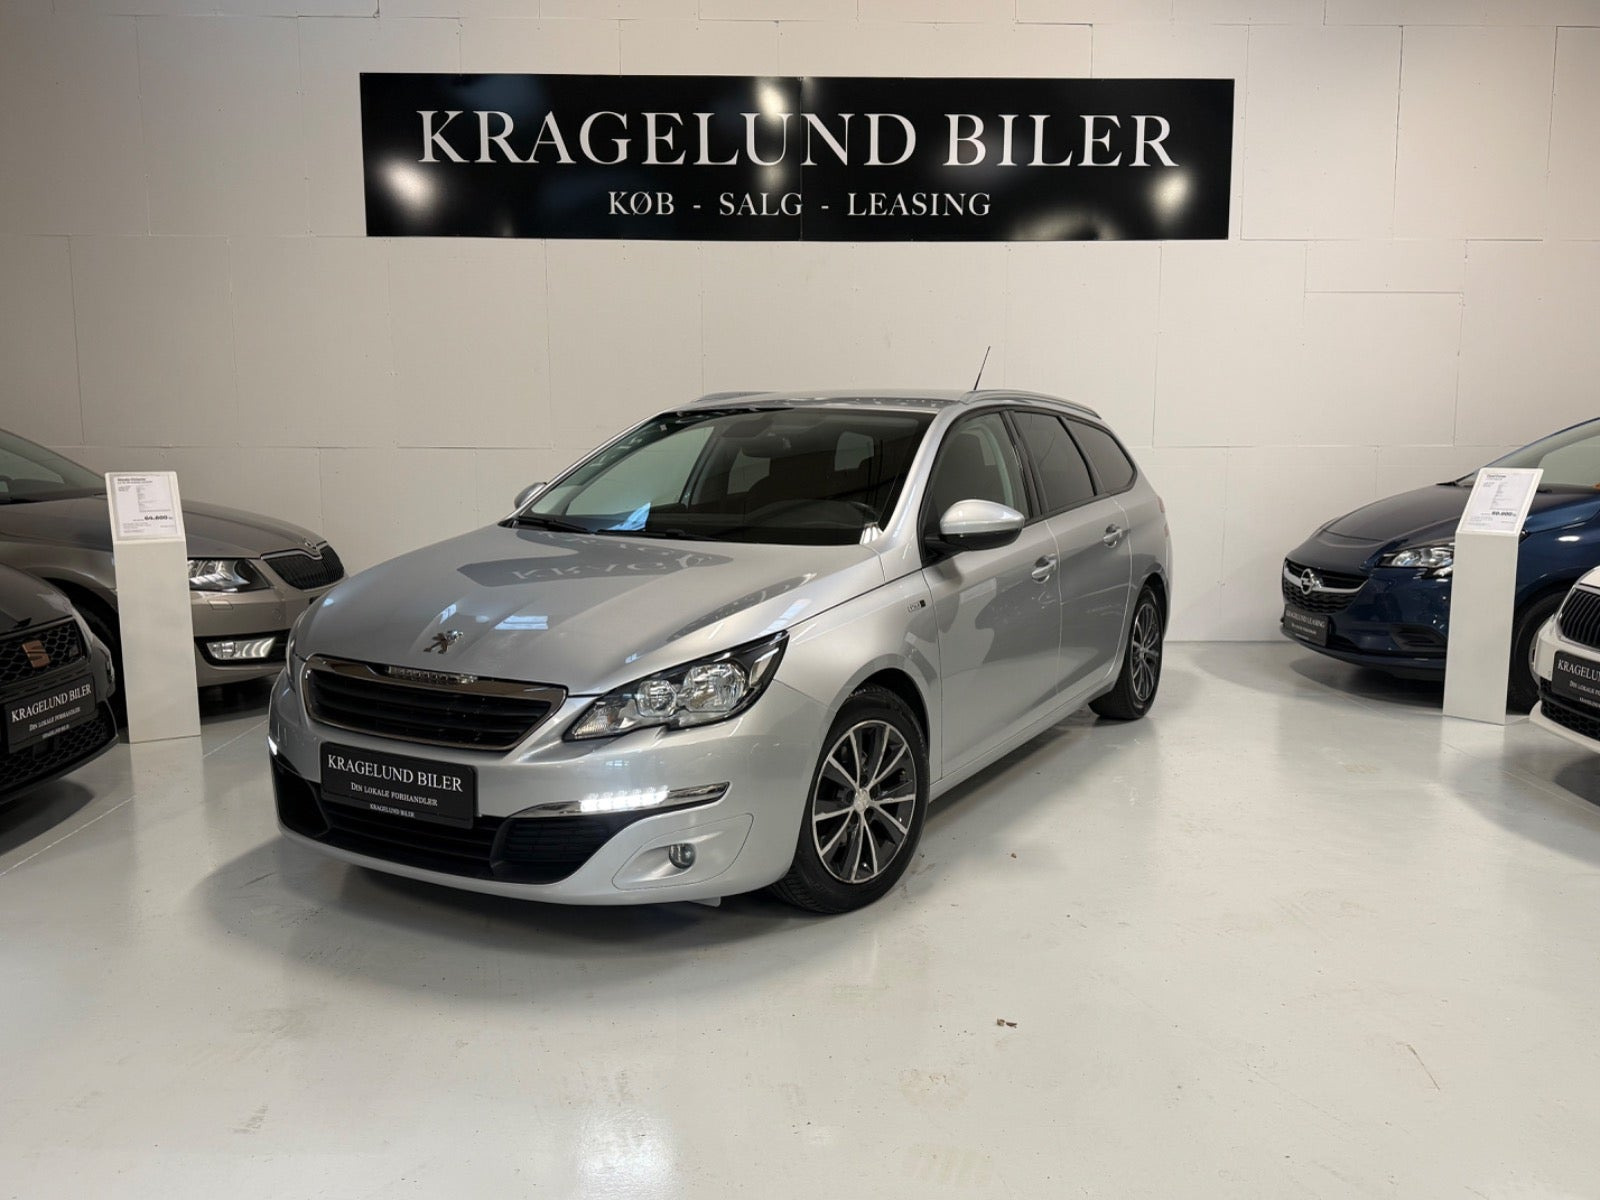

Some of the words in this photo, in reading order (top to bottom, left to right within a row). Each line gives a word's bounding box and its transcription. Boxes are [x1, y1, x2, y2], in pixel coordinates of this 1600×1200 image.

[416, 110, 917, 166] KRAGELUND
[942, 113, 1180, 167] BILER
[608, 191, 675, 216] KØB
[719, 192, 802, 216] SALG
[847, 192, 992, 217] LEASING
[11, 692, 69, 723] KRAGELUND
[69, 683, 92, 702] BILER
[327, 754, 414, 784] KRAGELUND
[417, 771, 464, 792] BILER
[364, 785, 390, 798] LOKALE
[391, 791, 438, 807] FORHANDLER
